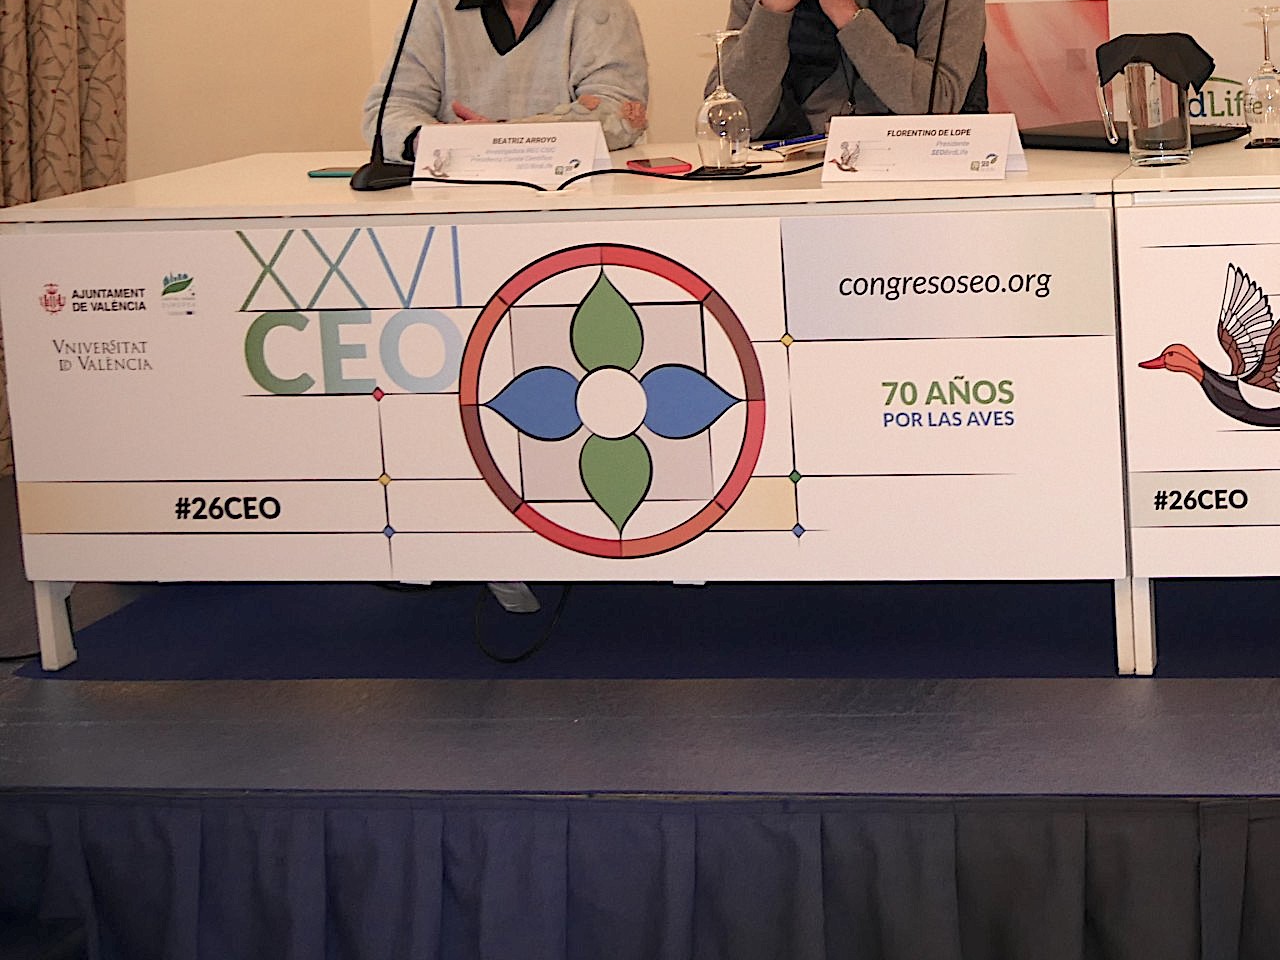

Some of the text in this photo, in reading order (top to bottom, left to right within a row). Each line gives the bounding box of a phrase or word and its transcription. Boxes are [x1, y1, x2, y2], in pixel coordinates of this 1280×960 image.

[1187, 90, 1263, 118] dLife
[492, 136, 557, 145] BEATRIZ ARROYO
[887, 129, 937, 137] FLORENTINO
[235, 226, 463, 312] XXVI
[71, 288, 146, 299] AJUNTAMENT
[839, 272, 1052, 301] congresoseo.org
[72, 301, 88, 312] DE
[244, 308, 464, 395] CEO
[881, 375, 1015, 406] 70 AÑOS
[883, 410, 1015, 427] POR LAS AVES
[174, 496, 282, 521] #26CEO
[1153, 488, 1249, 511] #26CEO
